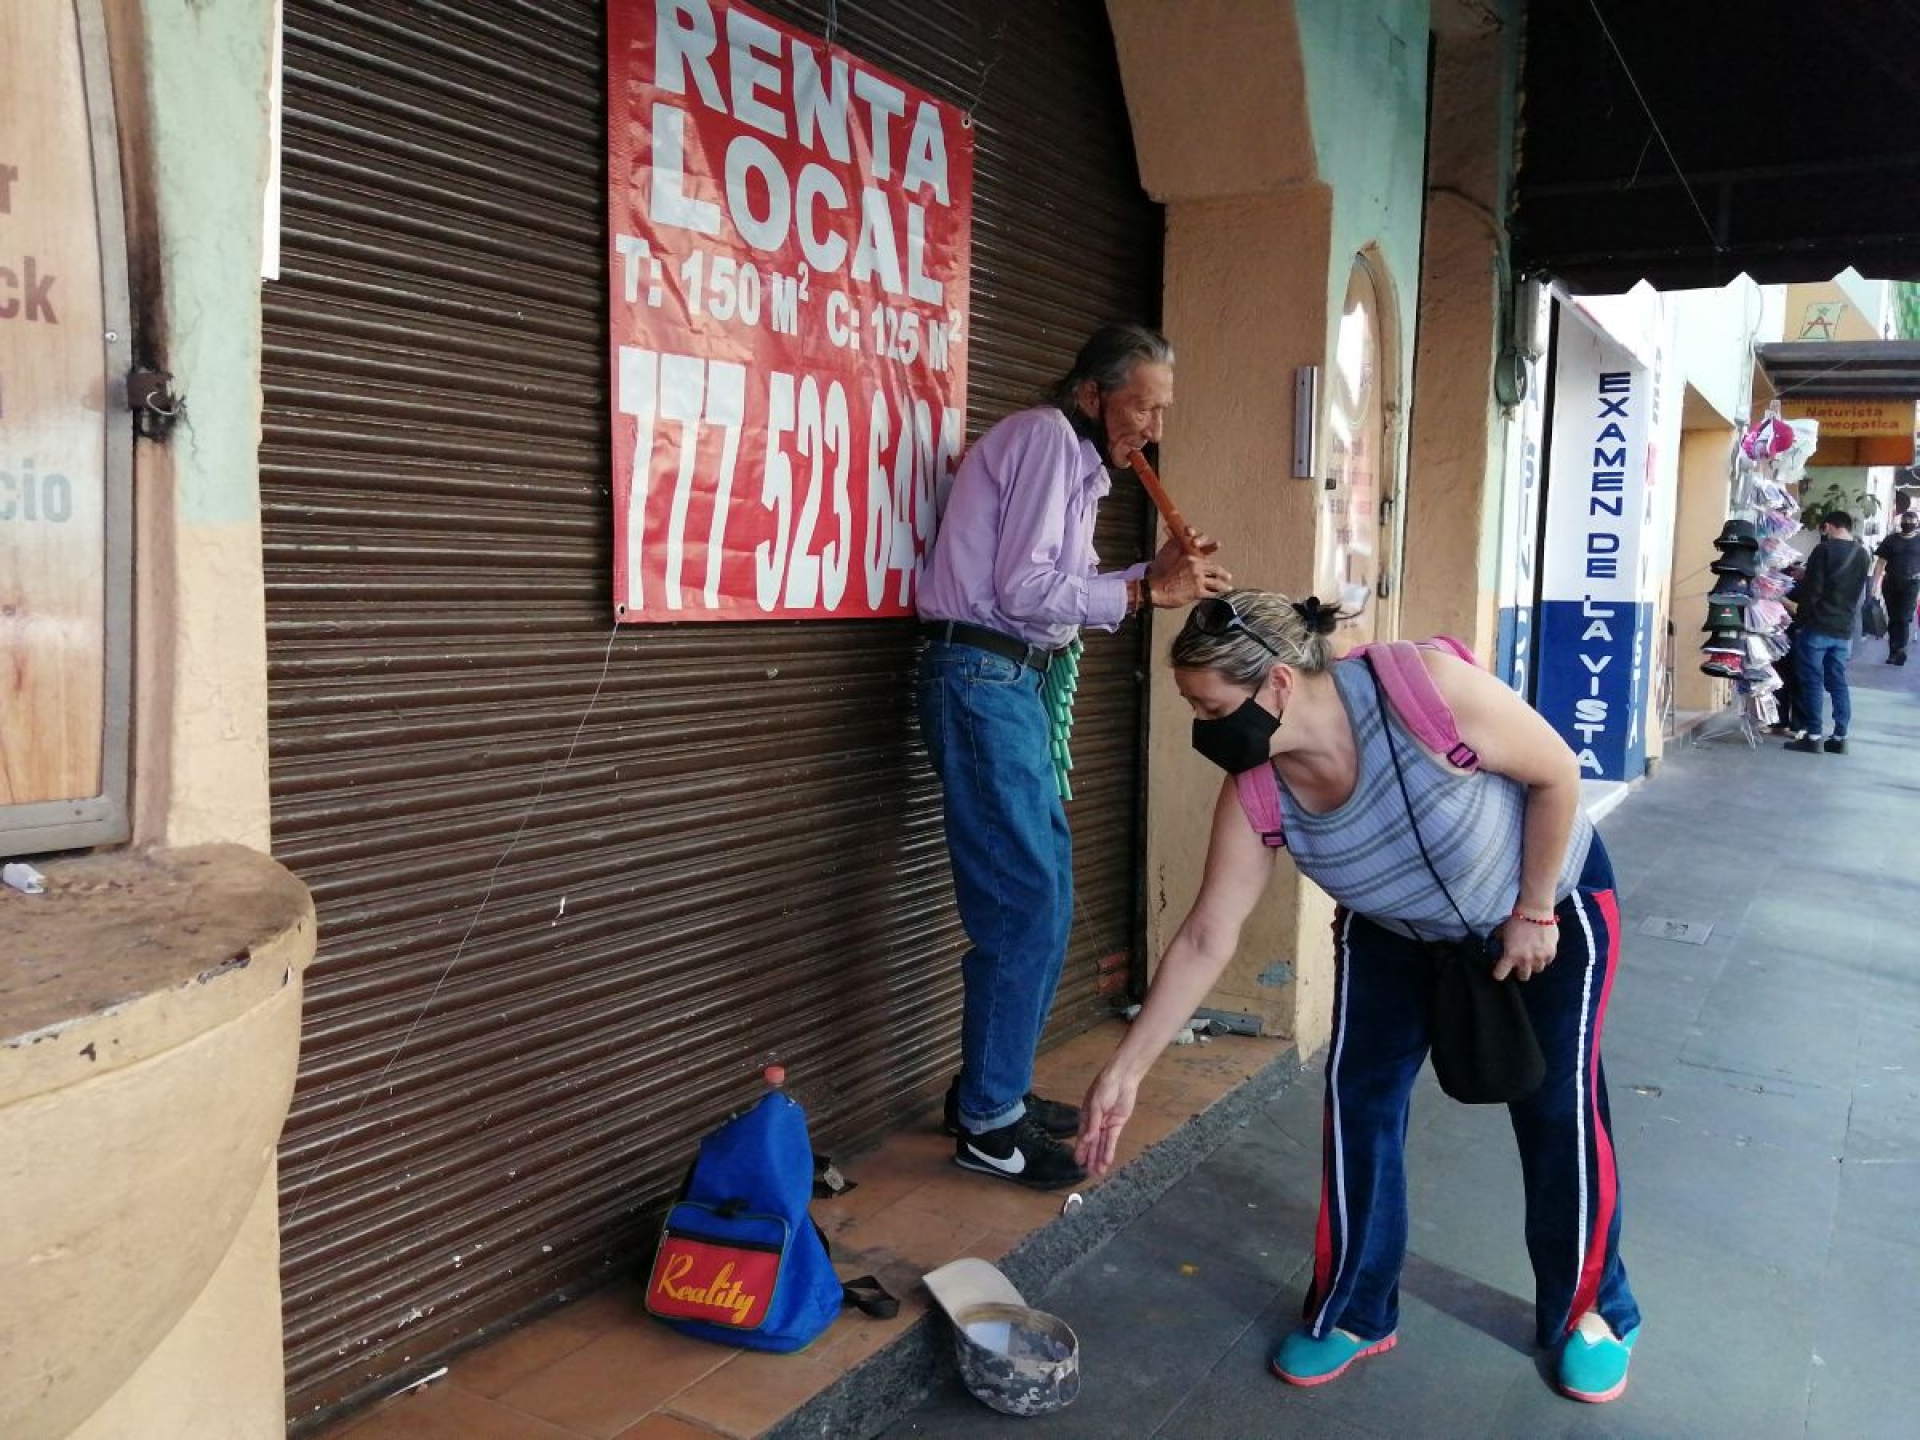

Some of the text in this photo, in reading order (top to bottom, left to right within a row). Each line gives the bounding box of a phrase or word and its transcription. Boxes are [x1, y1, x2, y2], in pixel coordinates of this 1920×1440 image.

[650, 103, 943, 306] LOCAL
[655, 0, 950, 206] RENTA
[615, 234, 662, 307] T:
[681, 250, 761, 326] 150
[827, 290, 860, 350] C:
[871, 301, 920, 365] 125
[619, 345, 746, 610] 777
[756, 371, 852, 612] 523
[1804, 405, 1883, 418] Naturista
[1573, 371, 1632, 777] EXAMEN DE LA VISTA
[657, 1253, 757, 1325] Reality
